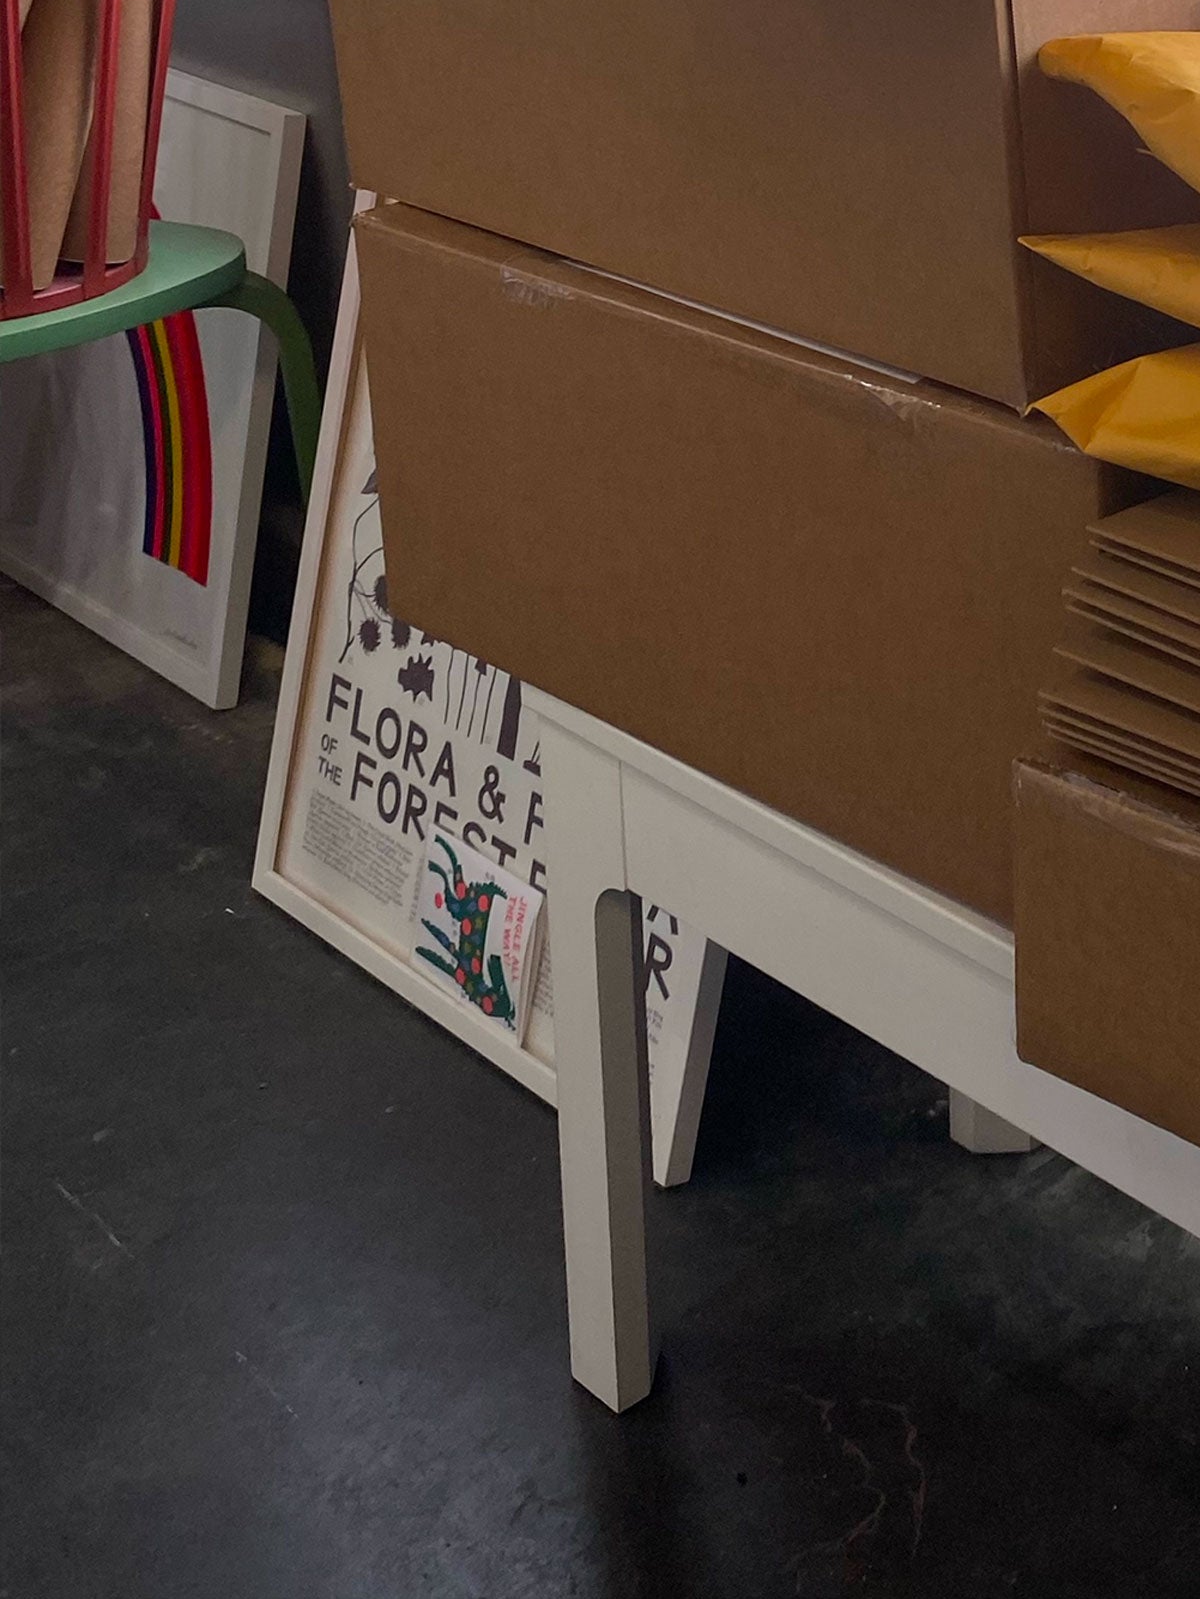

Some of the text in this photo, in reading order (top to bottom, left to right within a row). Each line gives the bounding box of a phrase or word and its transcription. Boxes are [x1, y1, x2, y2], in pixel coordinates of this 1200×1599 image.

[320, 733, 338, 755] OF
[326, 673, 457, 797] FLORA
[478, 765, 506, 824] &
[318, 756, 343, 786] THE
